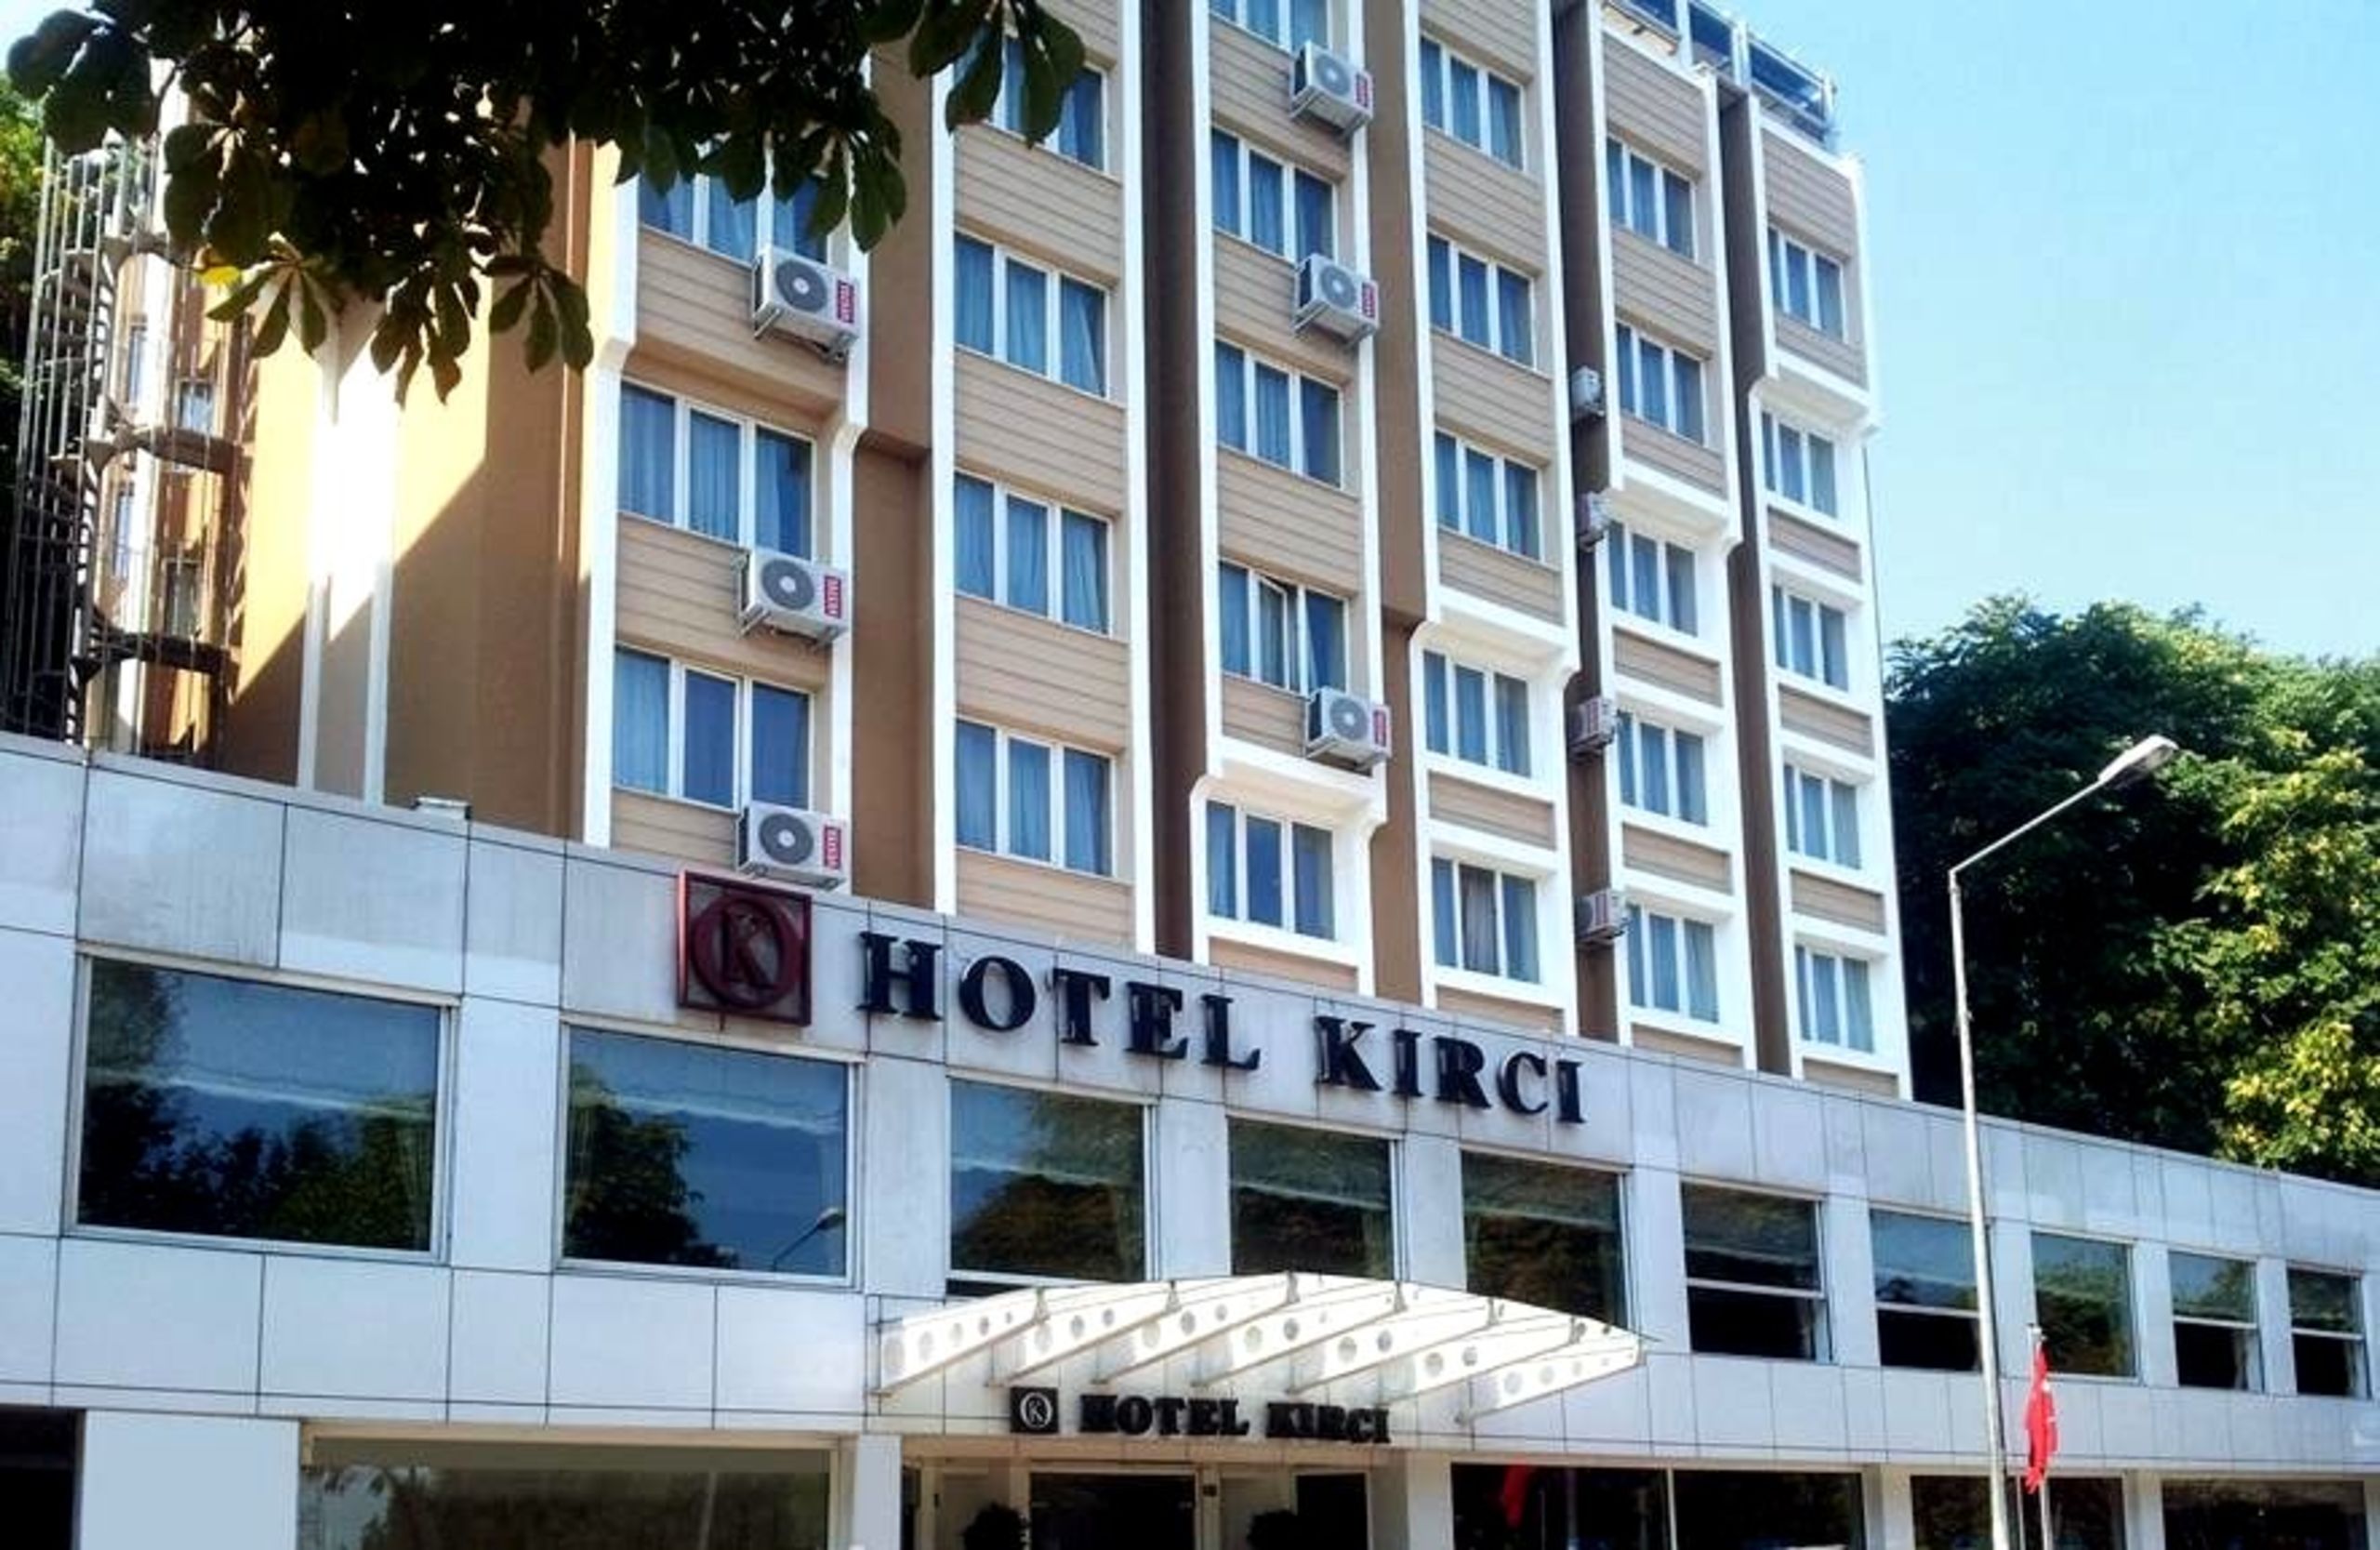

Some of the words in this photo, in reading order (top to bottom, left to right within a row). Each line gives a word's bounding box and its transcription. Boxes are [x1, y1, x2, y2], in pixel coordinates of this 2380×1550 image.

[856, 931, 1261, 1071] HOTEL
[1314, 1015, 1586, 1124] KIRCI
[1079, 1394, 1250, 1437] HOTEL
[1266, 1402, 1392, 1445] KIRCI
